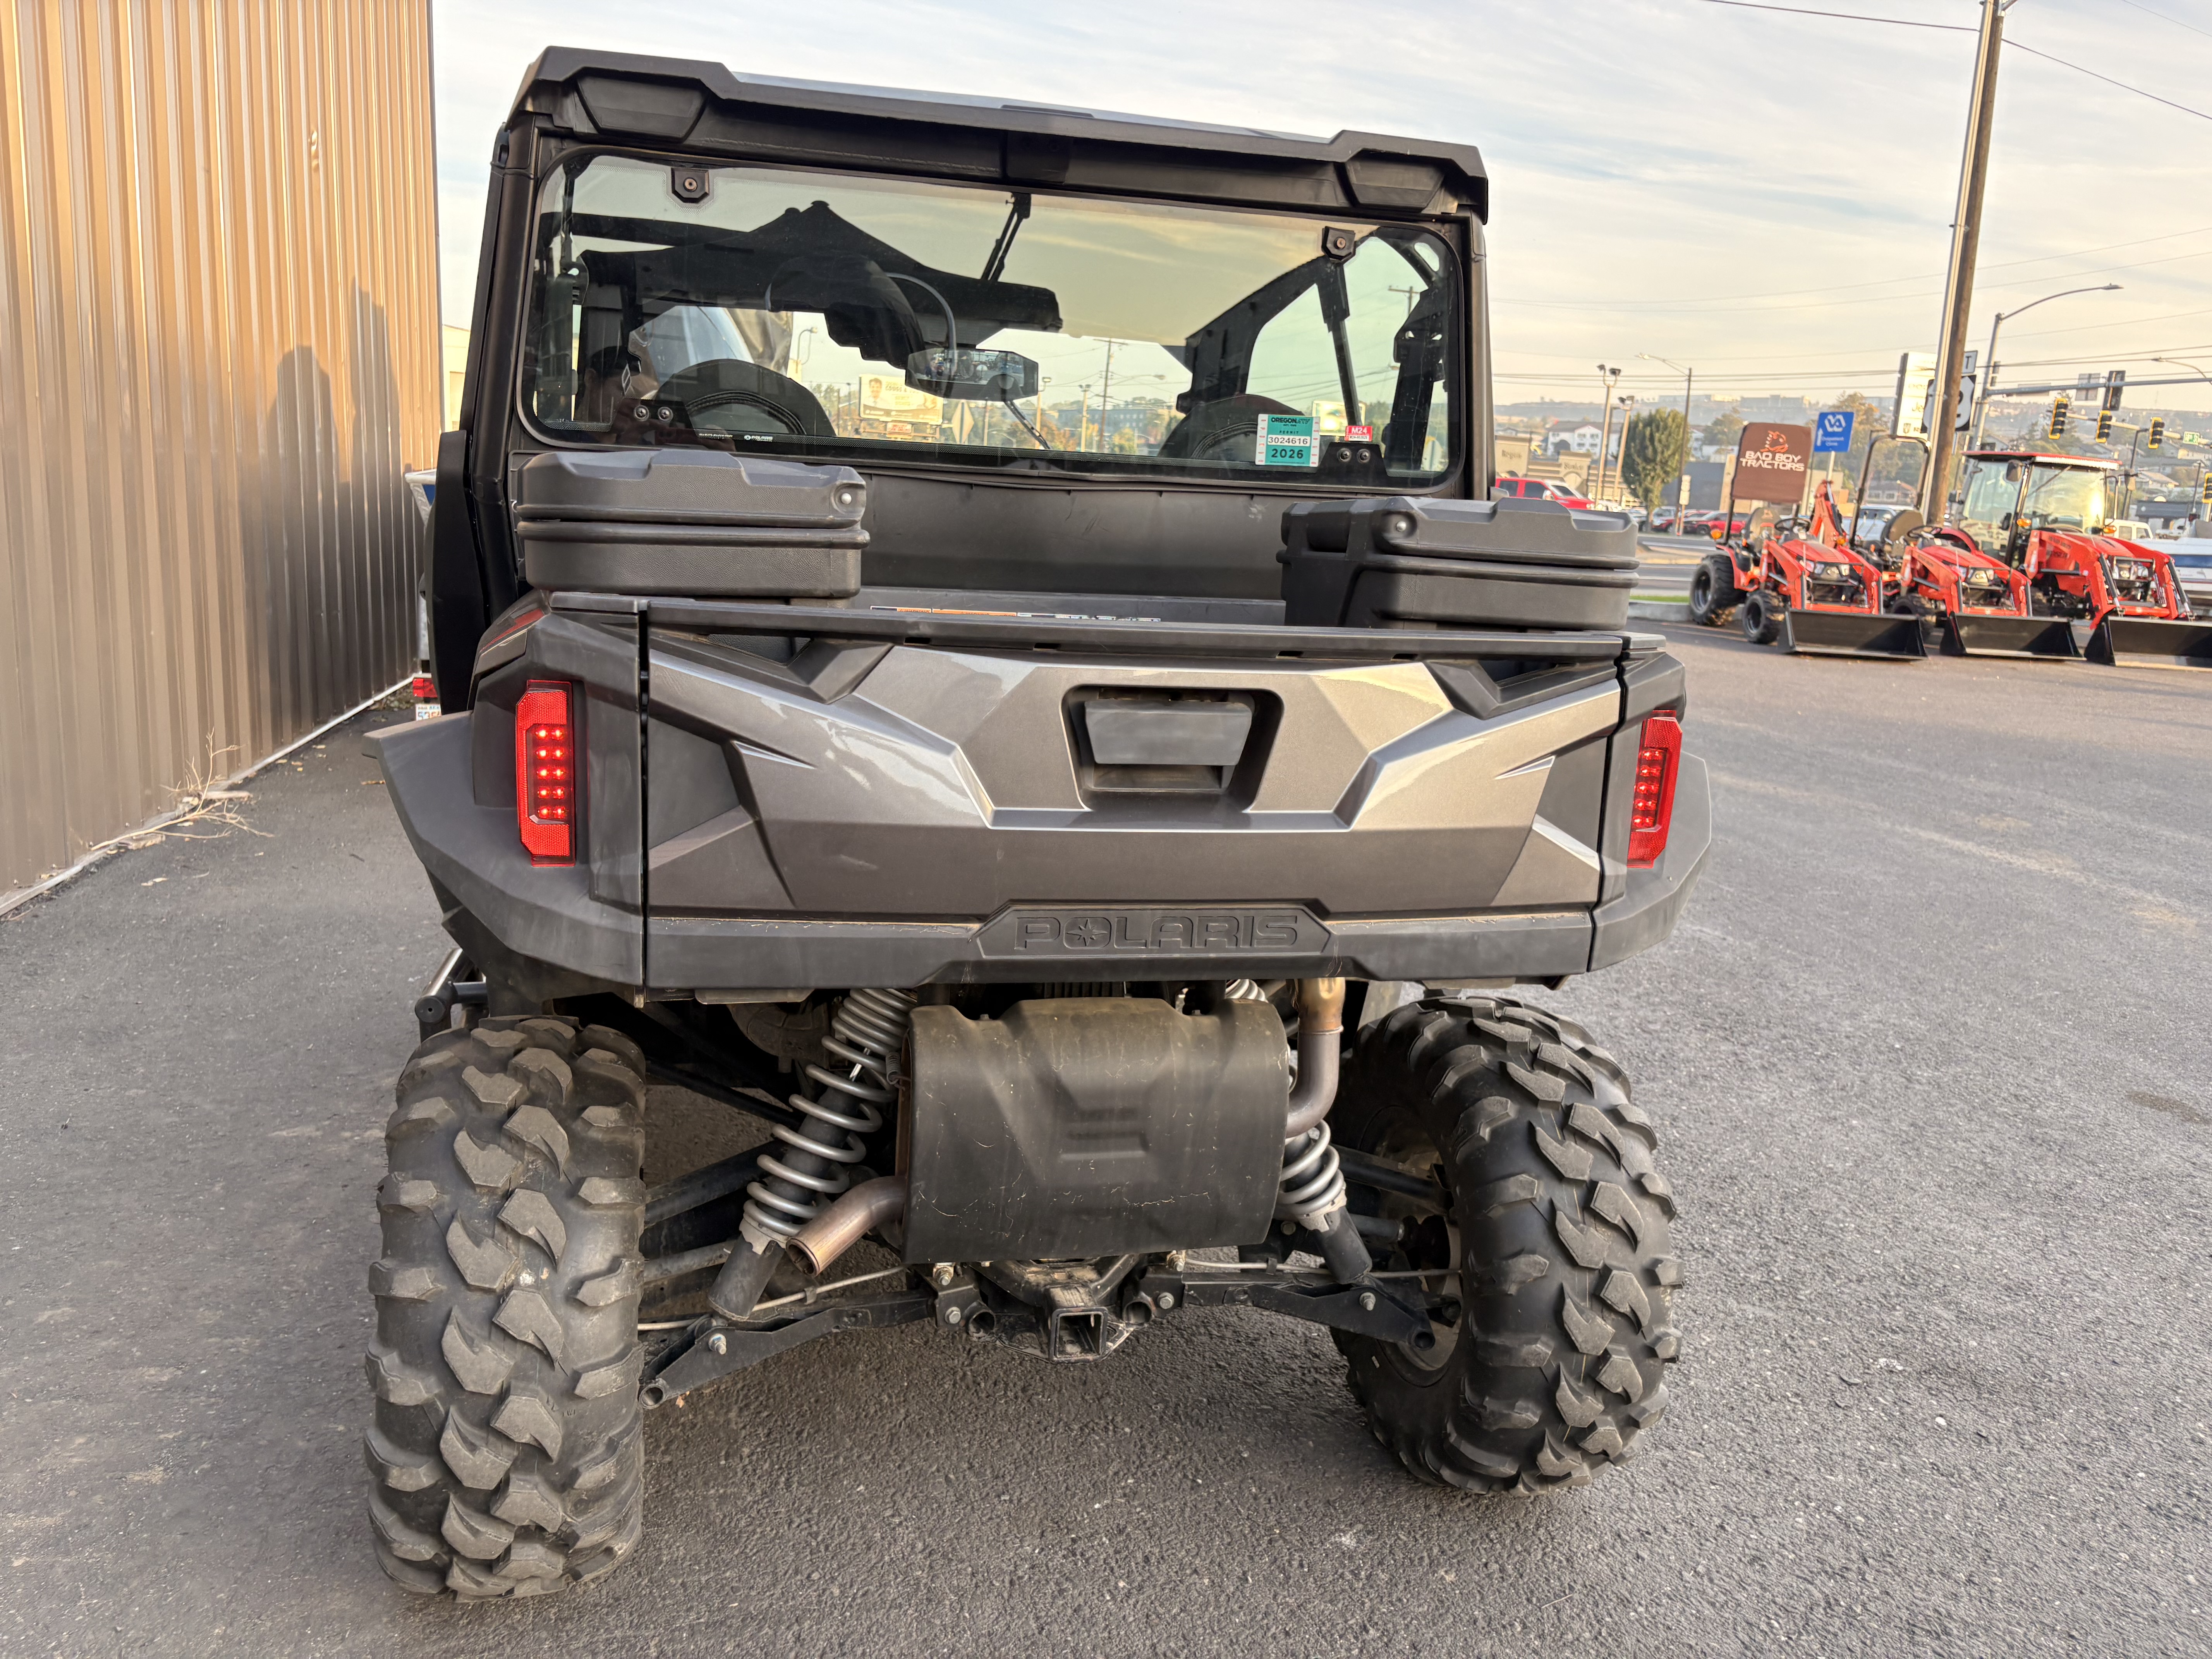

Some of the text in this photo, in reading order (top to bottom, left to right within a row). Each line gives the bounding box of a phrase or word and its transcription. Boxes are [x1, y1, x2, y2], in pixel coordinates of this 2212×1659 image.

[1271, 448, 1304, 459] 2026
[1745, 450, 1802, 463] BAD BOY
[1740, 458, 1805, 472] TRACTORS
[1014, 915, 1298, 950] POLARIS
